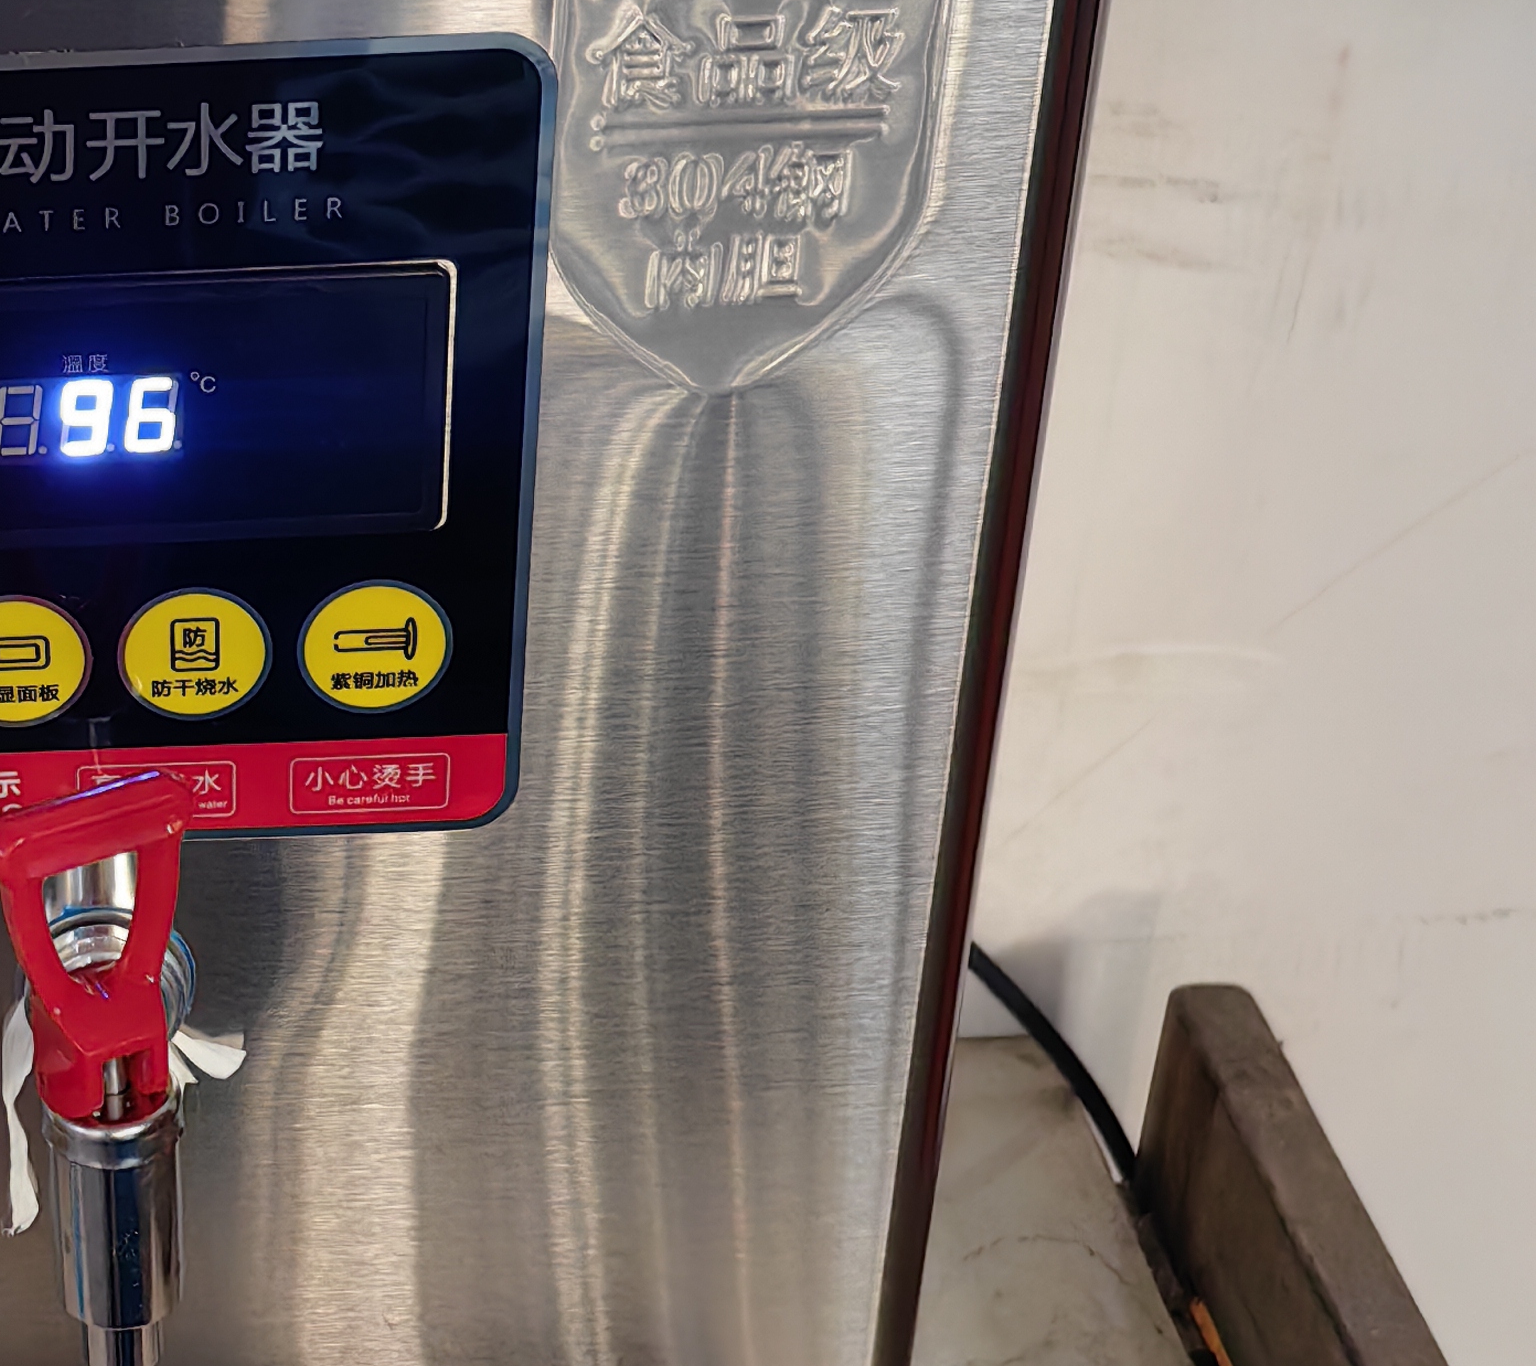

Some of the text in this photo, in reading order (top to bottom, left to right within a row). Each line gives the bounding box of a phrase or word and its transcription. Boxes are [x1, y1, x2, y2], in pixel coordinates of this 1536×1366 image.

[586, 5, 904, 109] 食品级
[165, 197, 343, 227] BOILER
[59, 376, 177, 457] 96
[182, 627, 206, 648] 防
[151, 678, 239, 698] 防干烧水
[330, 669, 419, 691] 紫铜加热
[305, 762, 437, 792] 小心烫手
